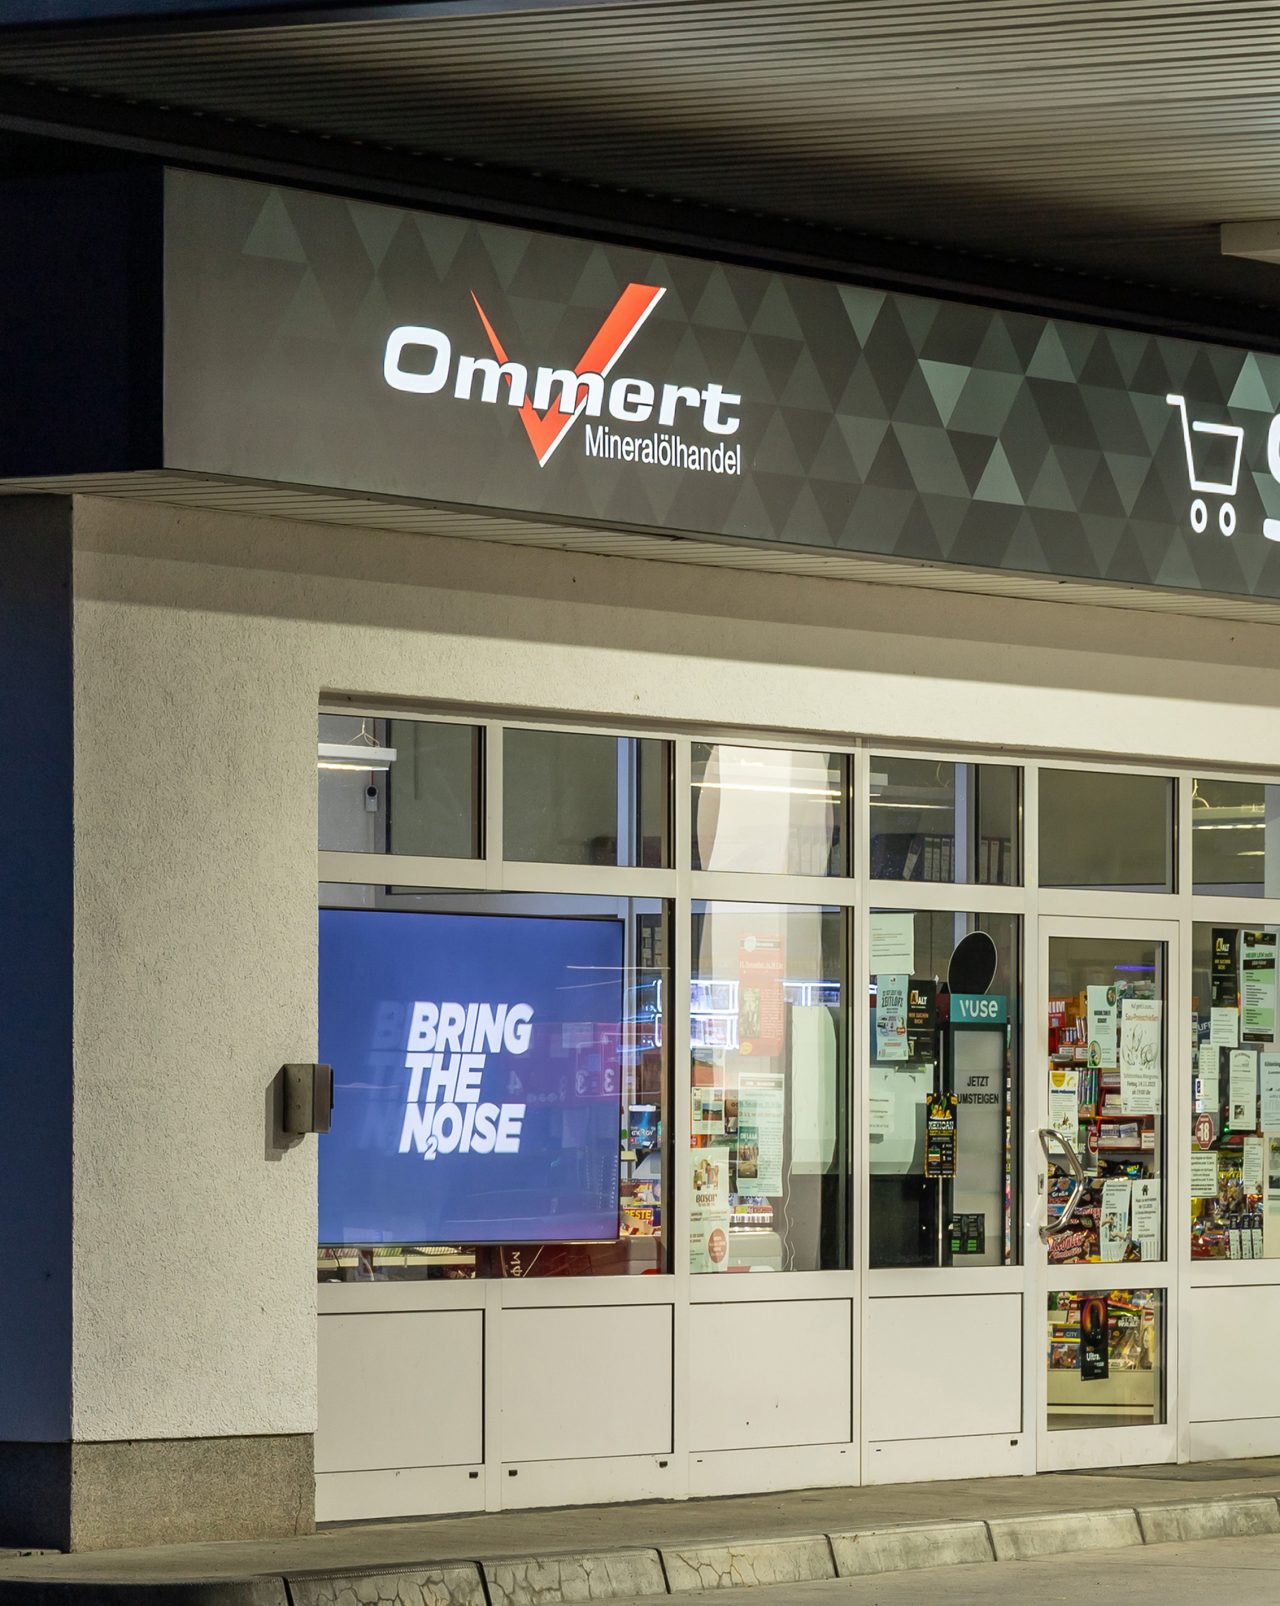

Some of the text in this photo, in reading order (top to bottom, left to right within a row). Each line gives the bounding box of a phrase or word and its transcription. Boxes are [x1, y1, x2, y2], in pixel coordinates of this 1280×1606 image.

[383, 325, 742, 435] Ommert
[585, 424, 742, 476] Mineralölhandel
[406, 1001, 535, 1055] BRING
[405, 1053, 487, 1103] THE
[957, 1093, 999, 1104] UMSTEIGEN
[967, 1076, 989, 1087] JETZT
